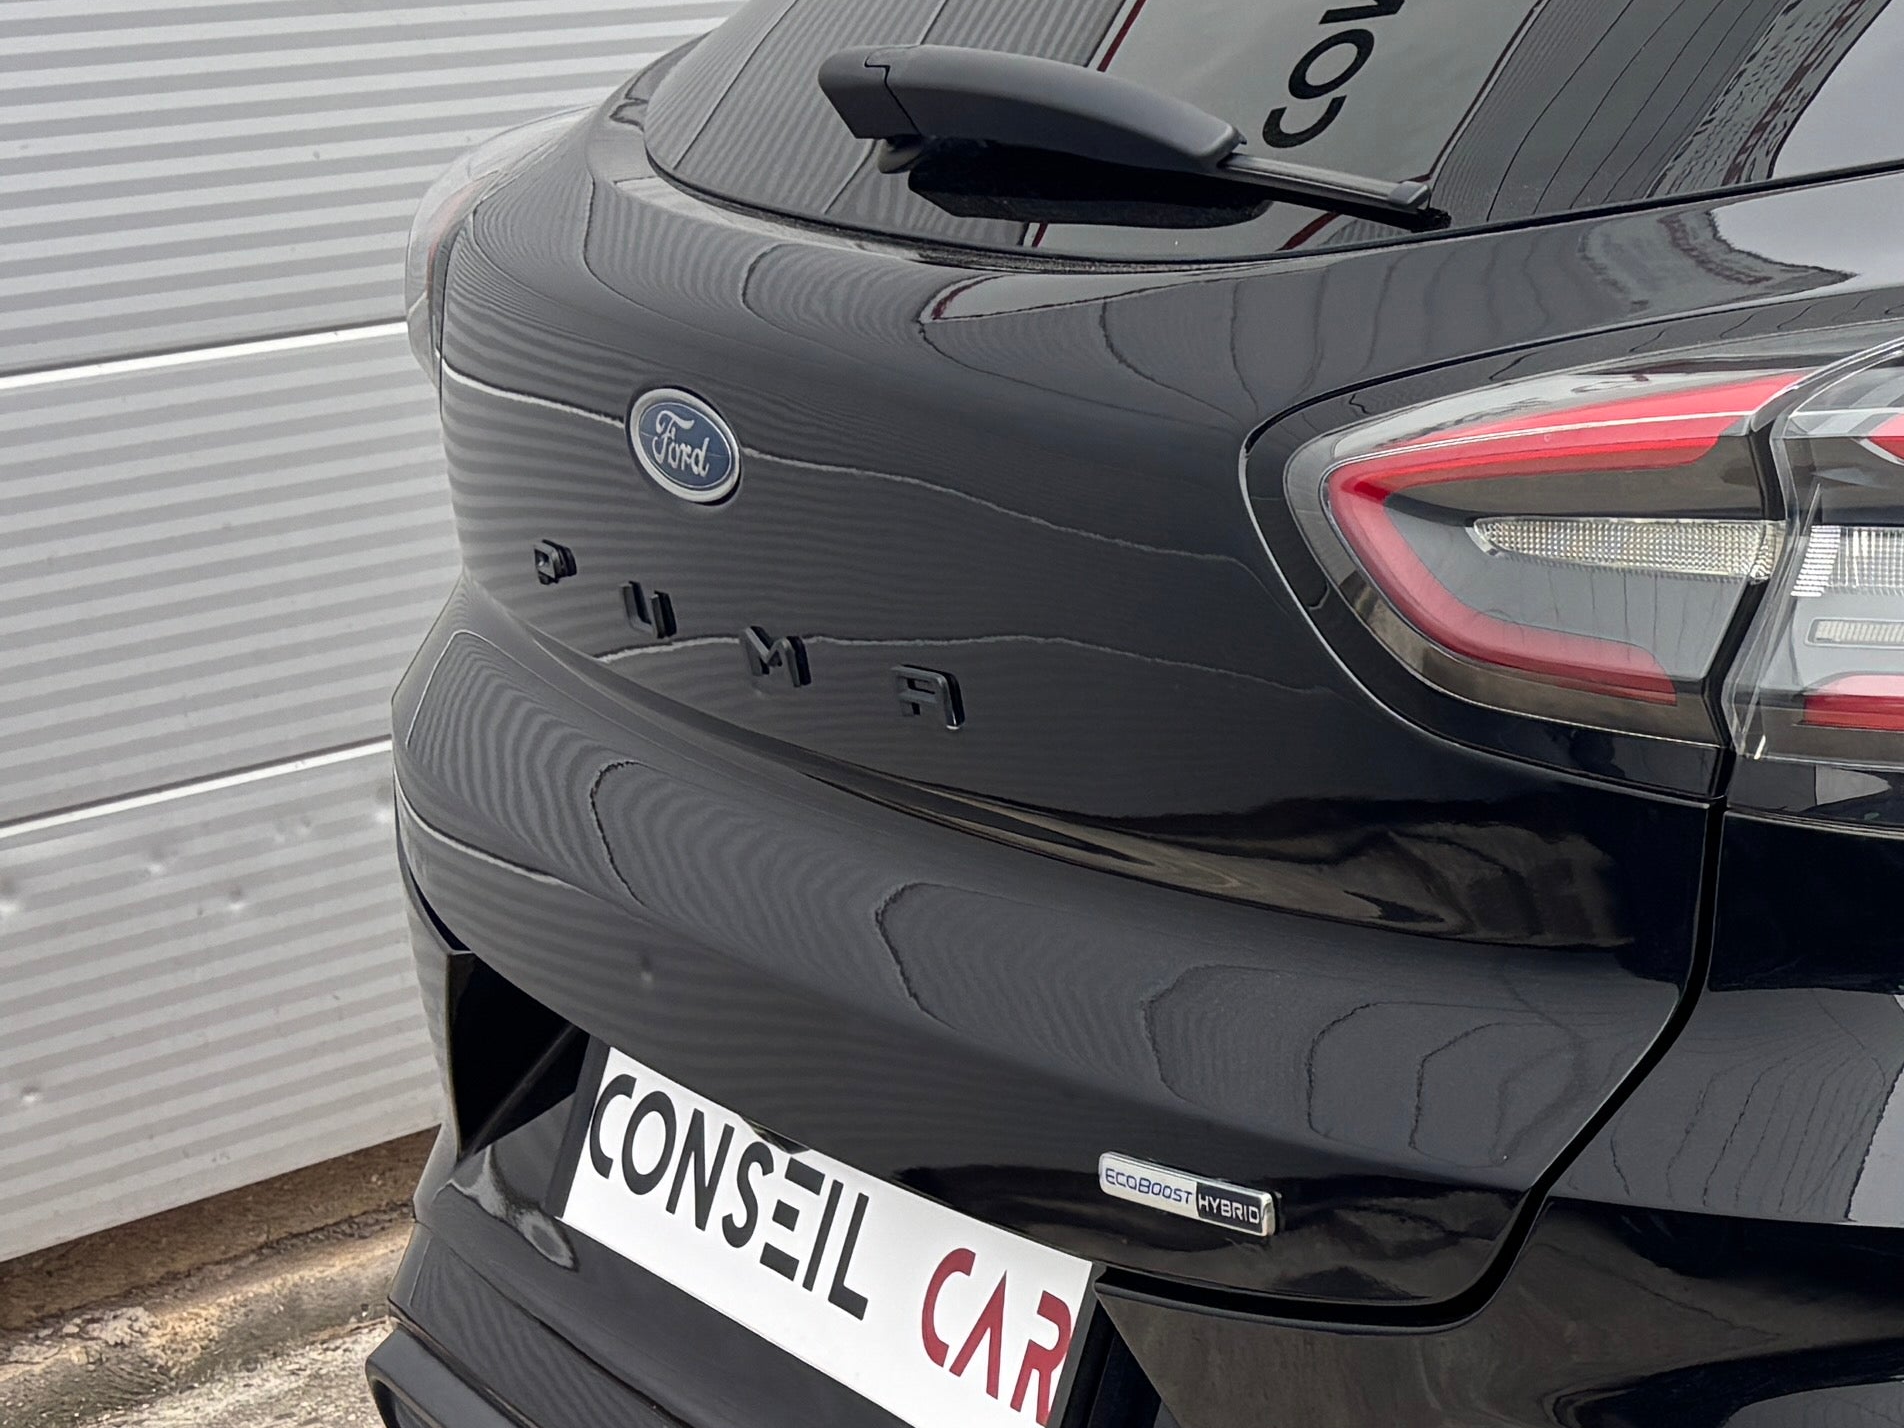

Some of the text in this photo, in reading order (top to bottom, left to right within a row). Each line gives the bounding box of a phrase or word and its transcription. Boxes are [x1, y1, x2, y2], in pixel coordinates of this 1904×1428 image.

[652, 410, 710, 478] Ford
[534, 539, 966, 730] PUMA
[589, 1073, 1072, 1427] CONSEIL CAR
[1199, 1193, 1260, 1224] HYBRID
